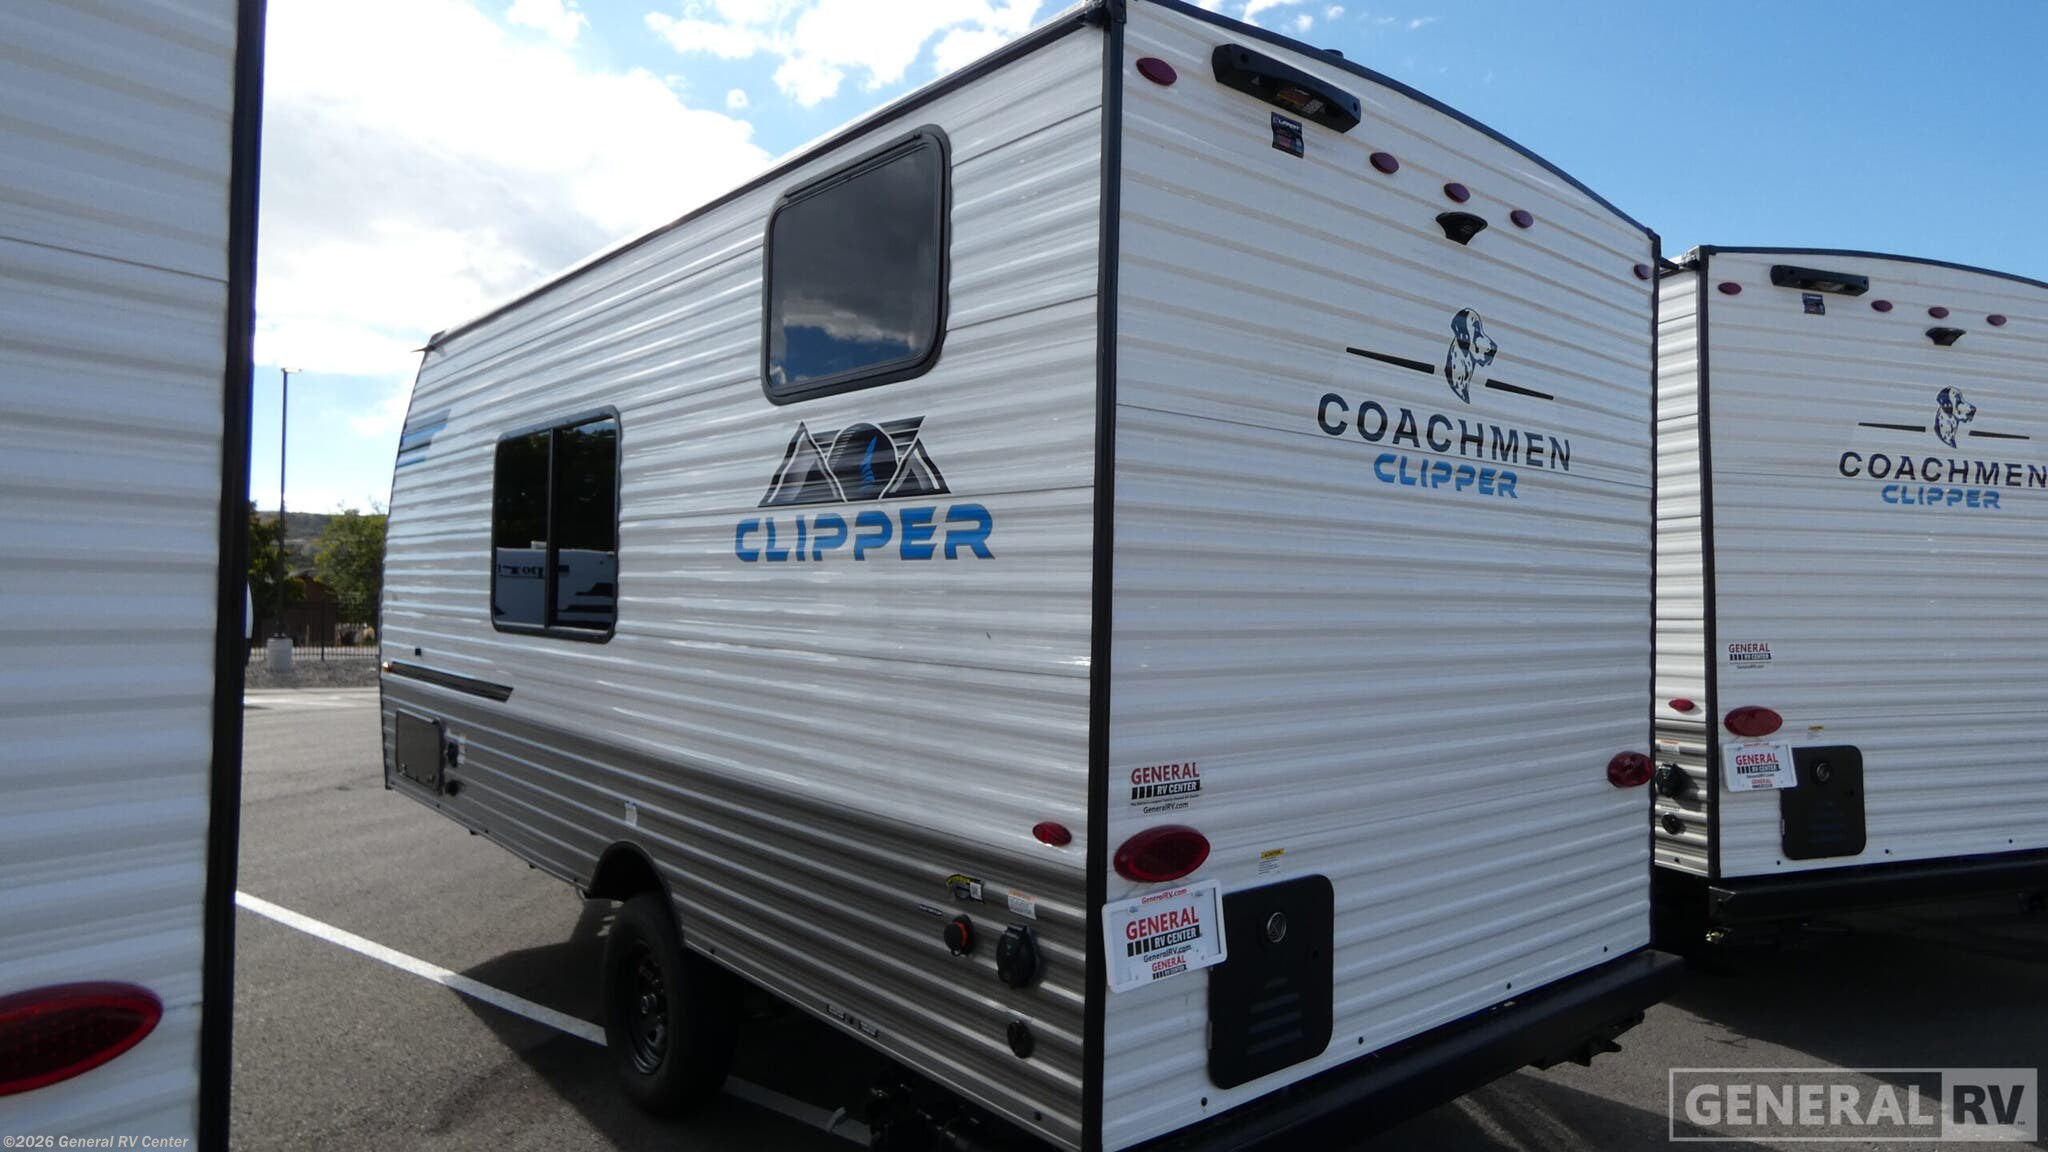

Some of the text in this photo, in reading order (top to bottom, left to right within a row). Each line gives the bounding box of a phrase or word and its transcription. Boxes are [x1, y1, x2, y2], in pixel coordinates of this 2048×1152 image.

[1317, 393, 1571, 472] COACHMEN
[1373, 453, 1519, 499] CLIPPER
[1839, 451, 2047, 488] COACHMEN
[1881, 485, 2001, 509] CLIPPER
[735, 503, 996, 562] CLIPPER
[1728, 643, 1771, 653] GENERAL
[1735, 753, 1778, 765] GENERAL
[1131, 762, 1200, 785] GENERAL
[1157, 782, 1197, 795] RV CENTER
[1143, 802, 1189, 814] GeneralRV.com
[1141, 888, 1187, 905] GeneralRV.com
[1126, 906, 1200, 941] GENERAL
[1154, 928, 1197, 948] RV CENTER
[1143, 944, 1192, 963] GeneralRV.com
[1152, 955, 1186, 972] GENERAL
